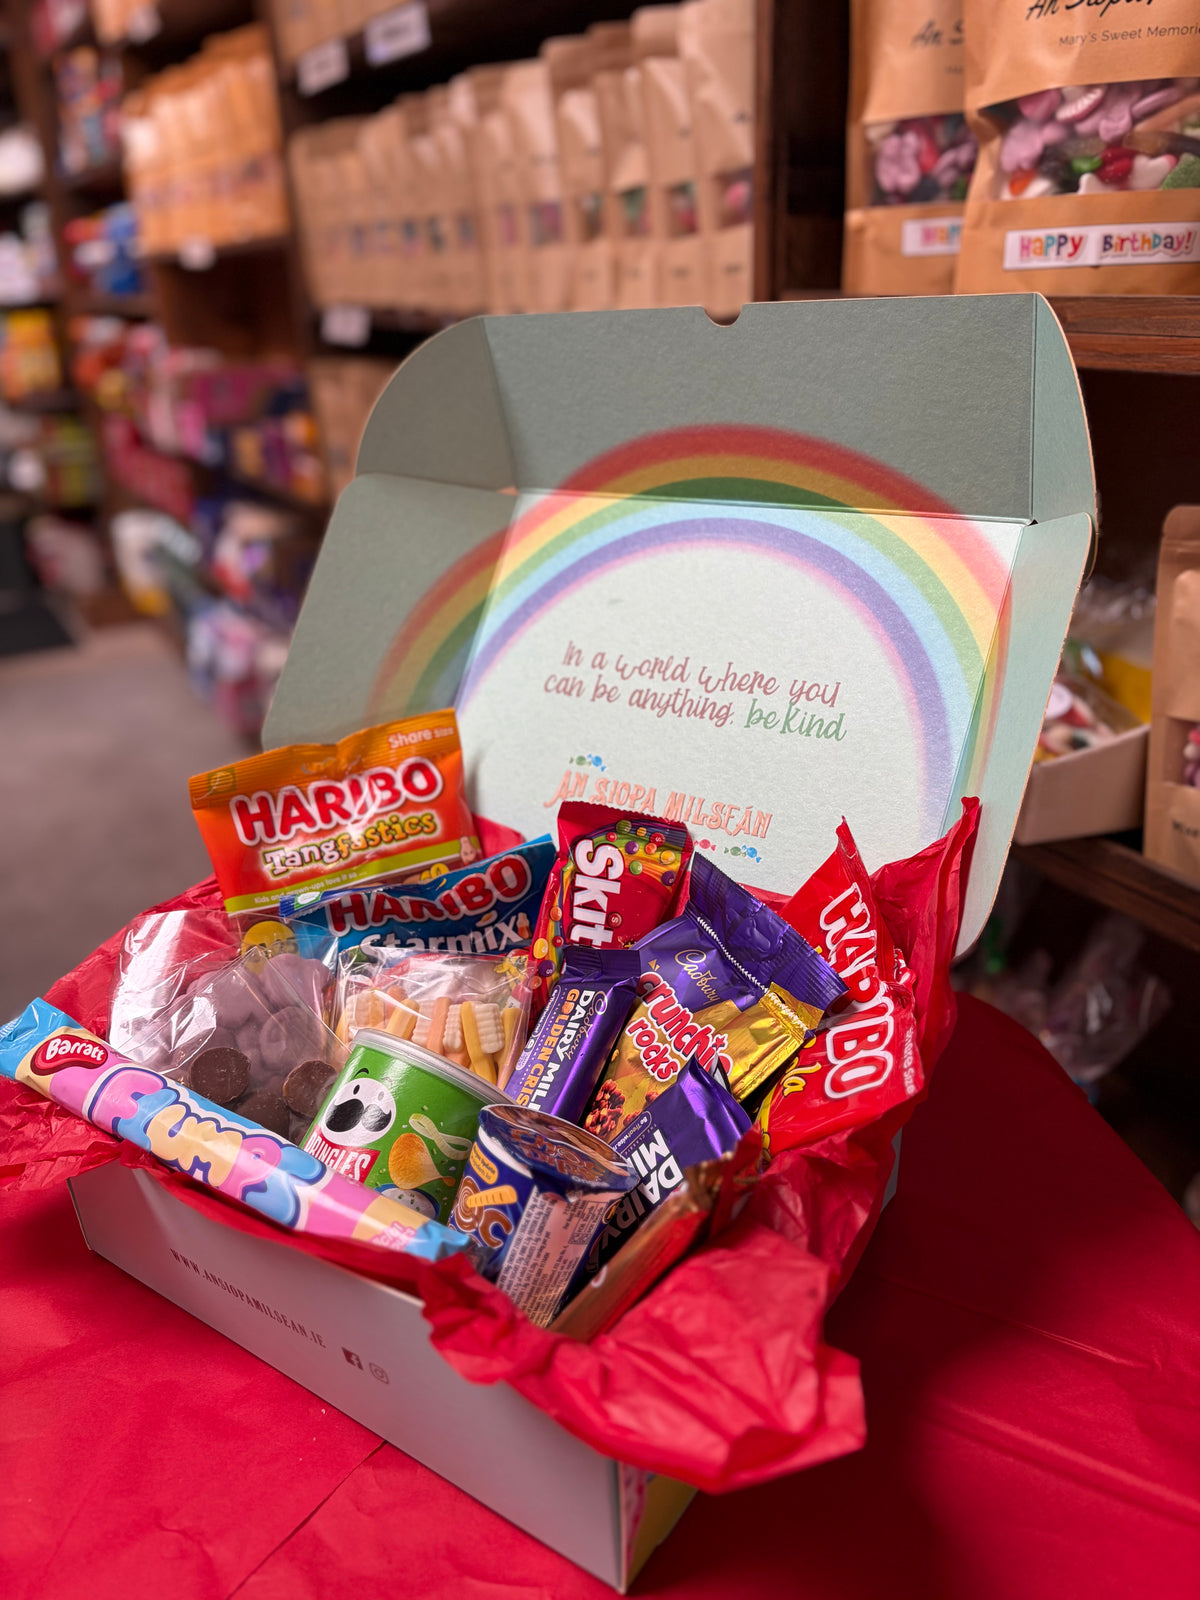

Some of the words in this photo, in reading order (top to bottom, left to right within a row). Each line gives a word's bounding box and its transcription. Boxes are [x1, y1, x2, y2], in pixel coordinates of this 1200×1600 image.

[1058, 32, 1098, 48] Mary's
[1101, 28, 1143, 42] Sweet
[543, 673, 586, 698] can
[589, 674, 622, 704] be
[743, 698, 781, 730] be
[561, 639, 584, 666] In
[590, 650, 609, 671] a
[614, 654, 691, 684] world
[699, 661, 780, 697] where
[788, 680, 842, 708] you
[387, 728, 433, 749] Share
[229, 757, 444, 846] HARIBO
[543, 769, 589, 808] AN
[588, 777, 657, 814] SIOPA
[661, 791, 774, 839] MILSEÁN
[263, 812, 437, 877] Tangfastics
[674, 948, 721, 1007] Cadbury
[45, 1037, 105, 1062] Barratt
[536, 988, 581, 1064] GOLDEN
[555, 989, 597, 1063] DAIRY
[564, 990, 608, 1061] Cadbury
[624, 1016, 681, 1083] rocks
[600, 1154, 685, 1251] DAIRY
